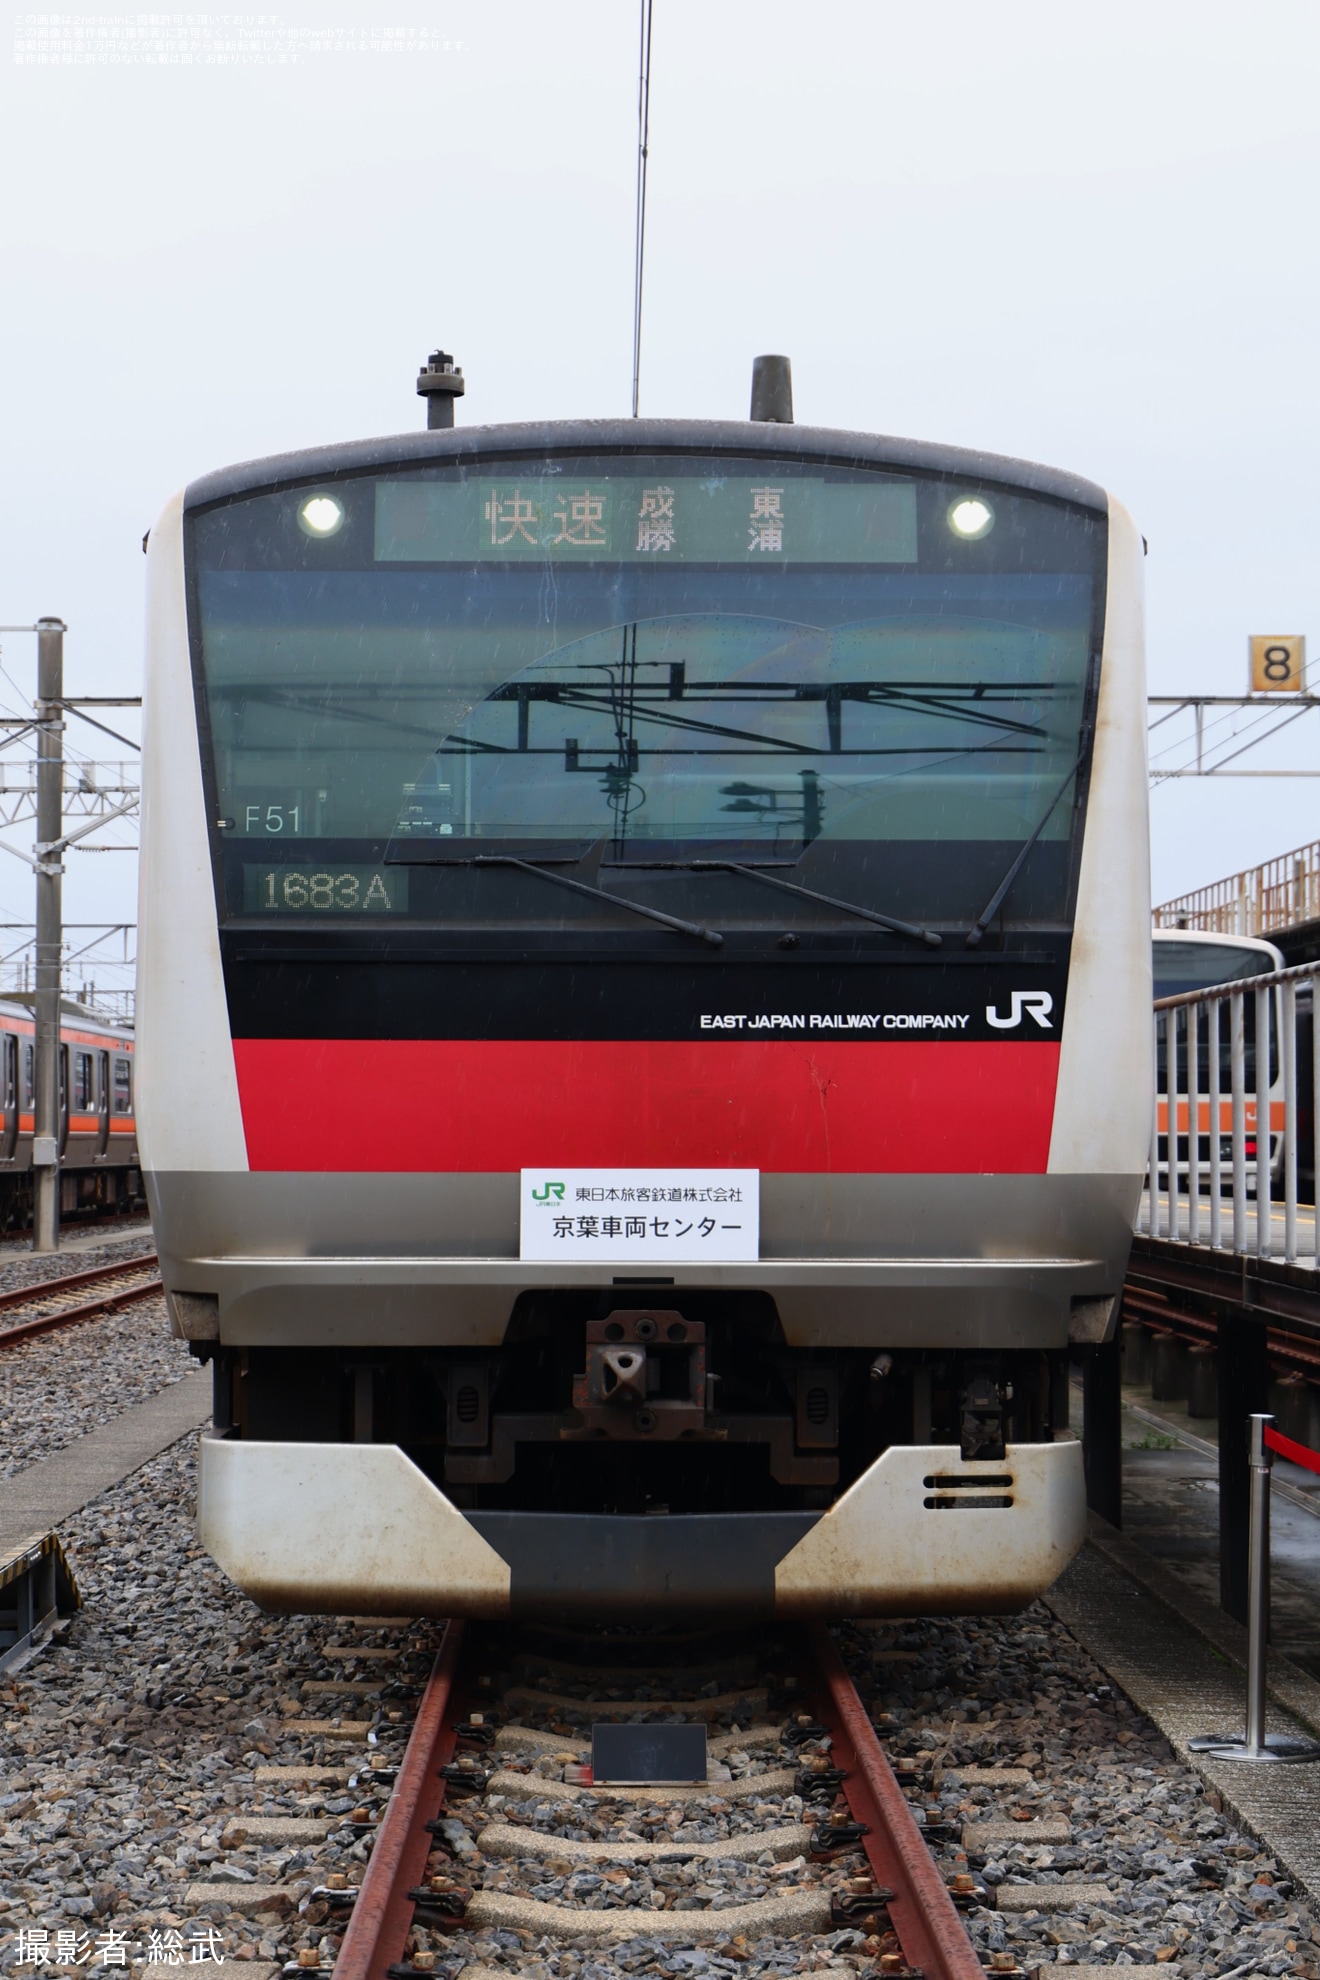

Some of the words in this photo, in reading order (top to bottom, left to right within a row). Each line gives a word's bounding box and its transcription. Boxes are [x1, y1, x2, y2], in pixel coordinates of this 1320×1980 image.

[485, 489, 606, 544] 快速
[1263, 645, 1291, 681] 8
[245, 806, 299, 832] F51
[265, 873, 391, 908] 1683A
[700, 1014, 747, 1029] EAST
[748, 1014, 807, 1029] JAPAN
[809, 1014, 880, 1029] RAILWAY
[883, 1014, 970, 1029] COMPANY
[985, 990, 1054, 1029] JR
[532, 1182, 565, 1200] JR
[552, 1215, 742, 1239] 京葉車両センター
